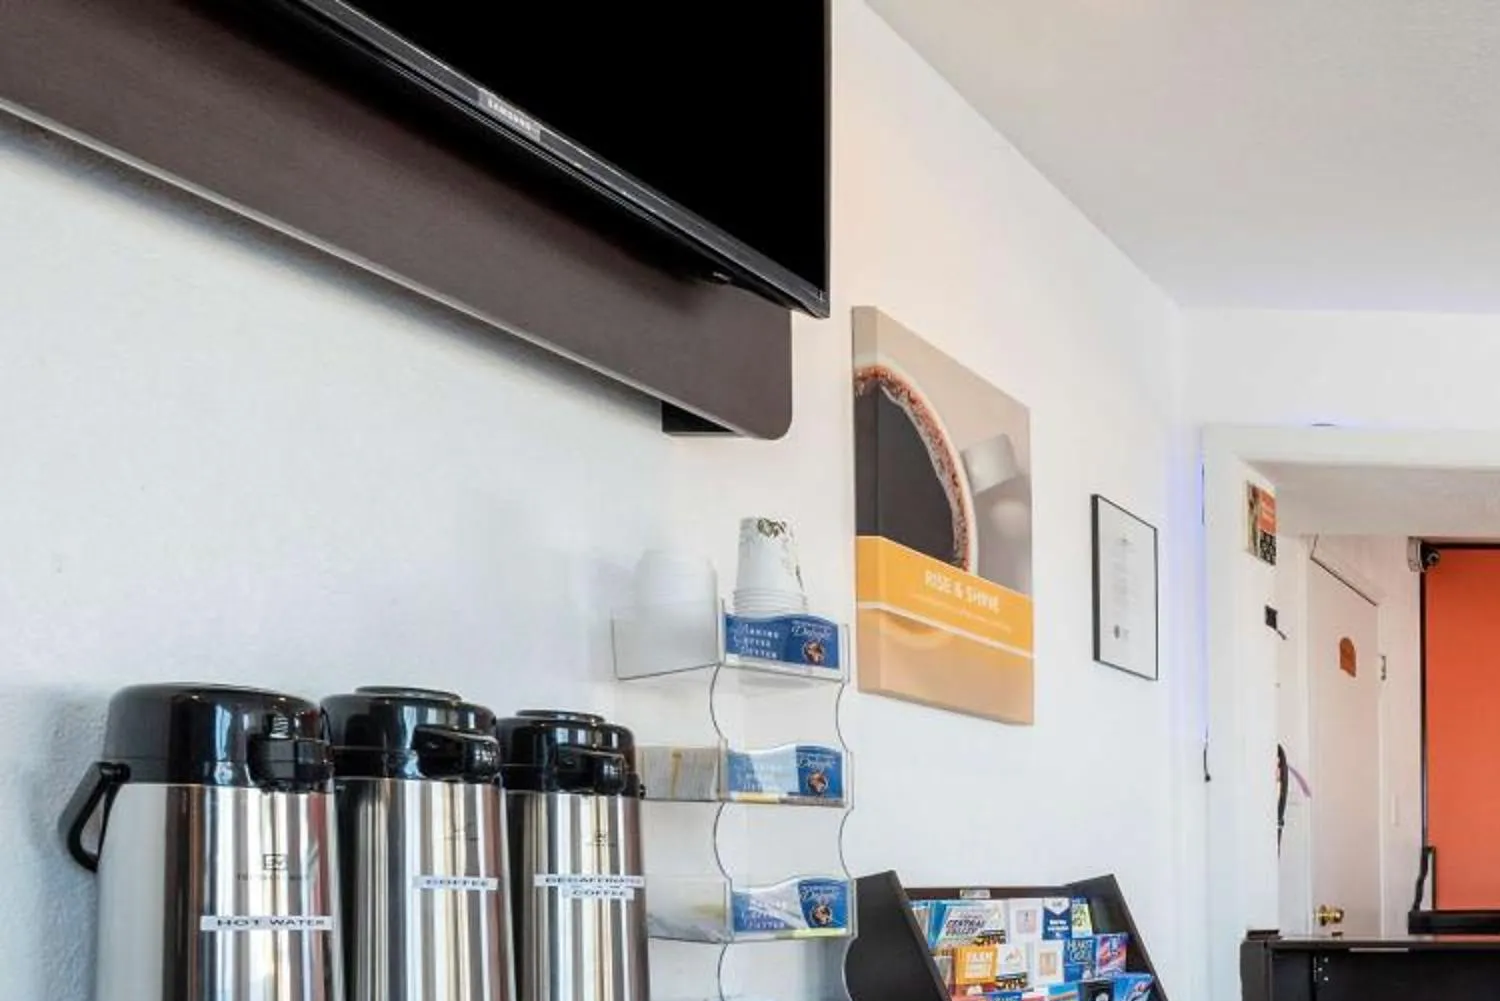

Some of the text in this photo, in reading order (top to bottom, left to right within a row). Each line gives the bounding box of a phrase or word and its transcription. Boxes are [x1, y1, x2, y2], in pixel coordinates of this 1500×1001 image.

[924, 569, 953, 594] RISE
[425, 878, 488, 887] COFFEE
[216, 919, 325, 927] HOT WATER
